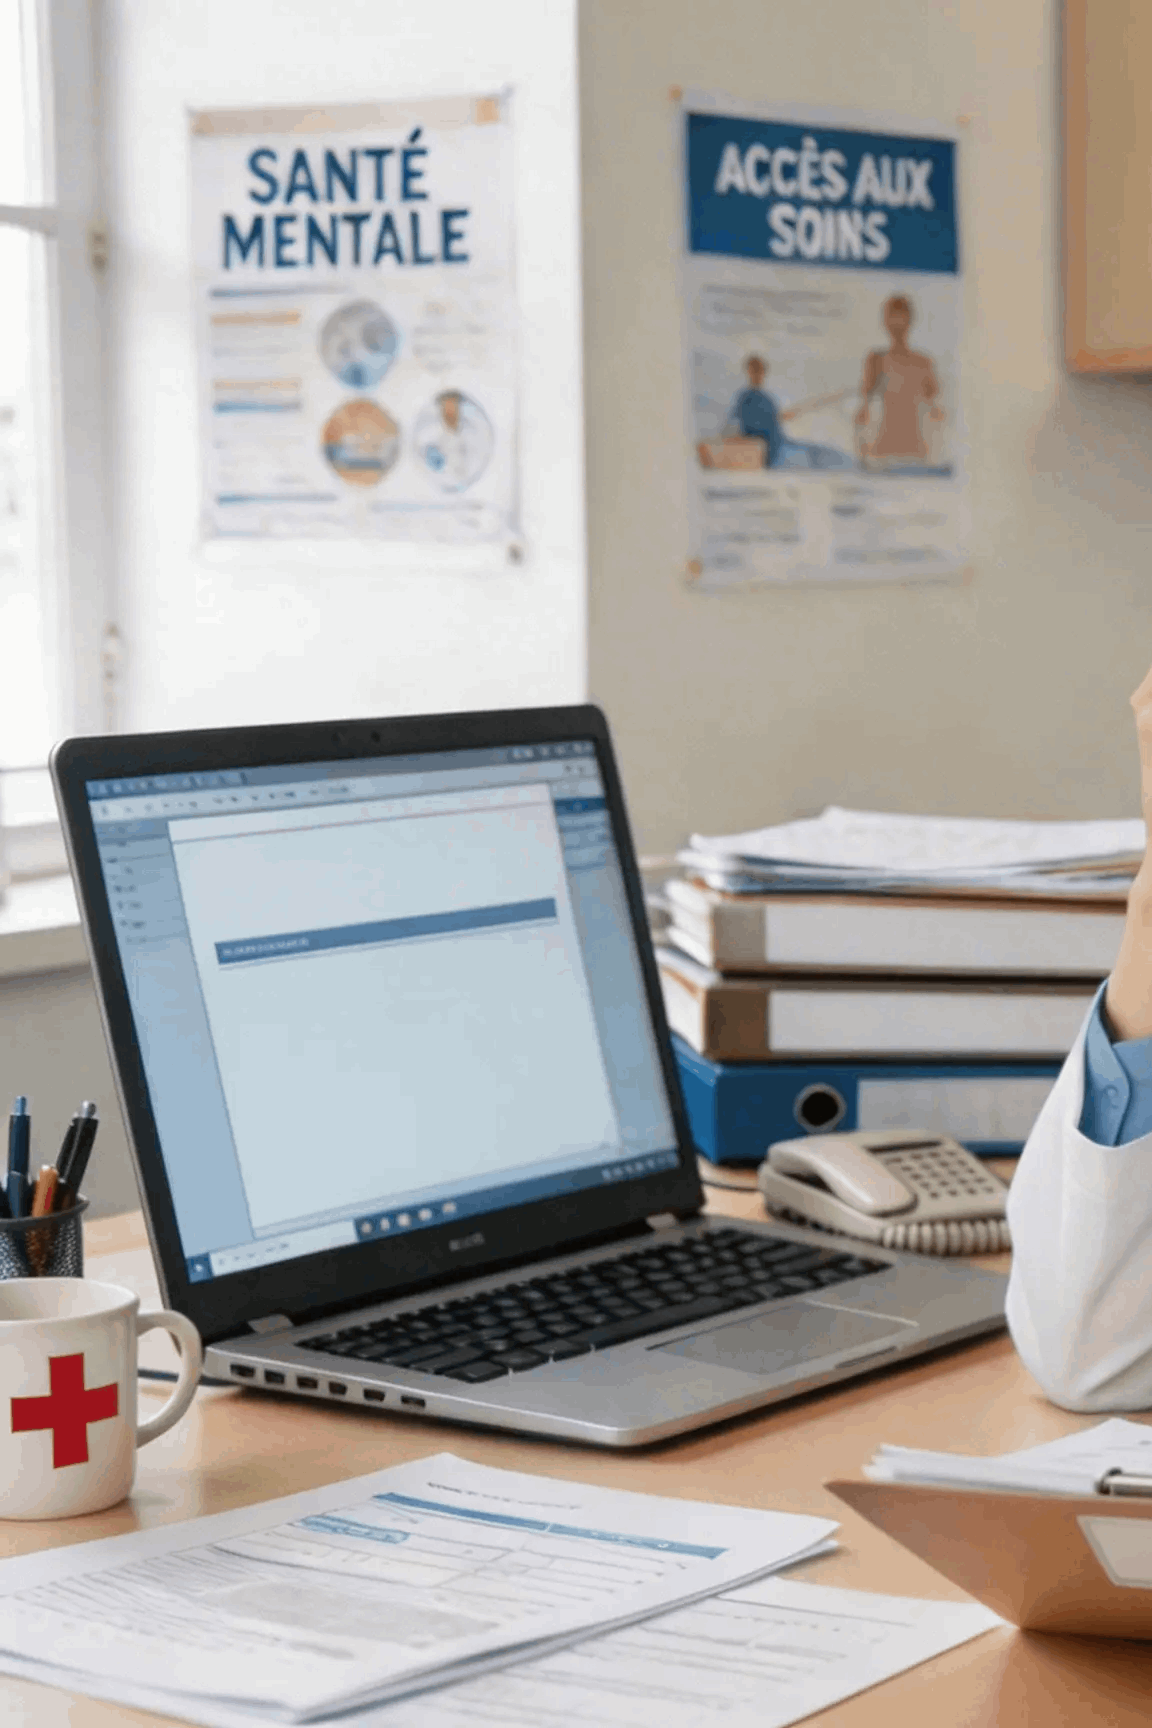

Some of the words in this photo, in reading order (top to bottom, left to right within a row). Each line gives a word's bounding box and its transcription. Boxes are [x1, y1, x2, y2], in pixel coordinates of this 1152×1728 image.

[247, 126, 429, 206] SANTÉ
[714, 135, 849, 201] ACCÈS
[852, 151, 935, 211] AUX
[221, 207, 470, 270] MENTALE
[767, 202, 892, 262] SOINS
